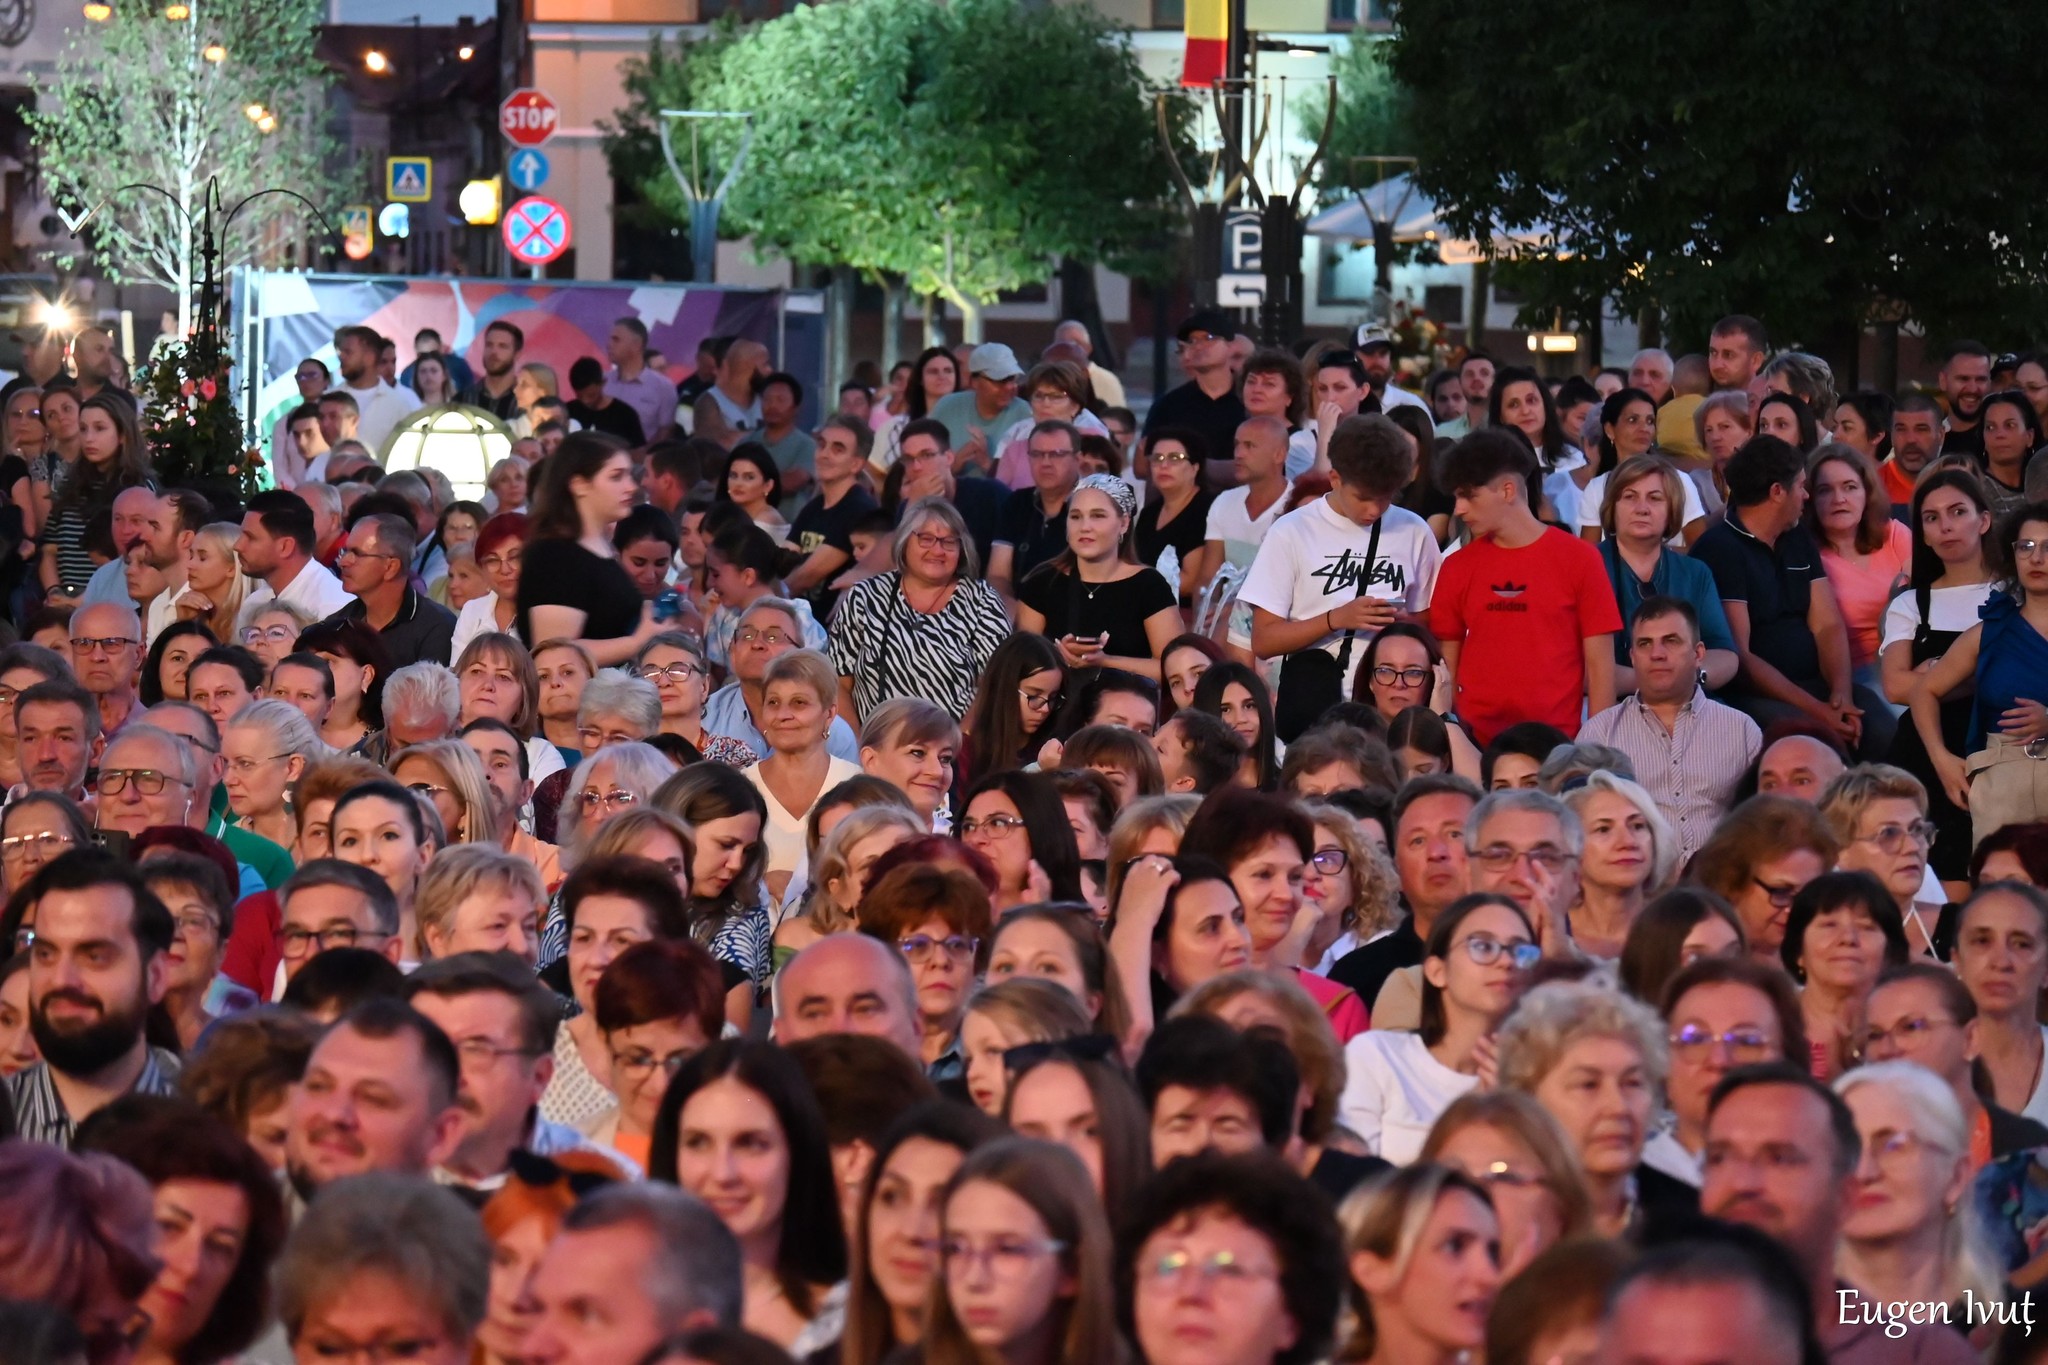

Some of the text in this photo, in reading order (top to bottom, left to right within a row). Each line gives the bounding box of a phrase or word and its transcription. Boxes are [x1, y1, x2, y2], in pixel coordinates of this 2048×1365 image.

[504, 107, 556, 130] STOP
[1232, 224, 1262, 270] P
[1486, 600, 1528, 612] adidas
